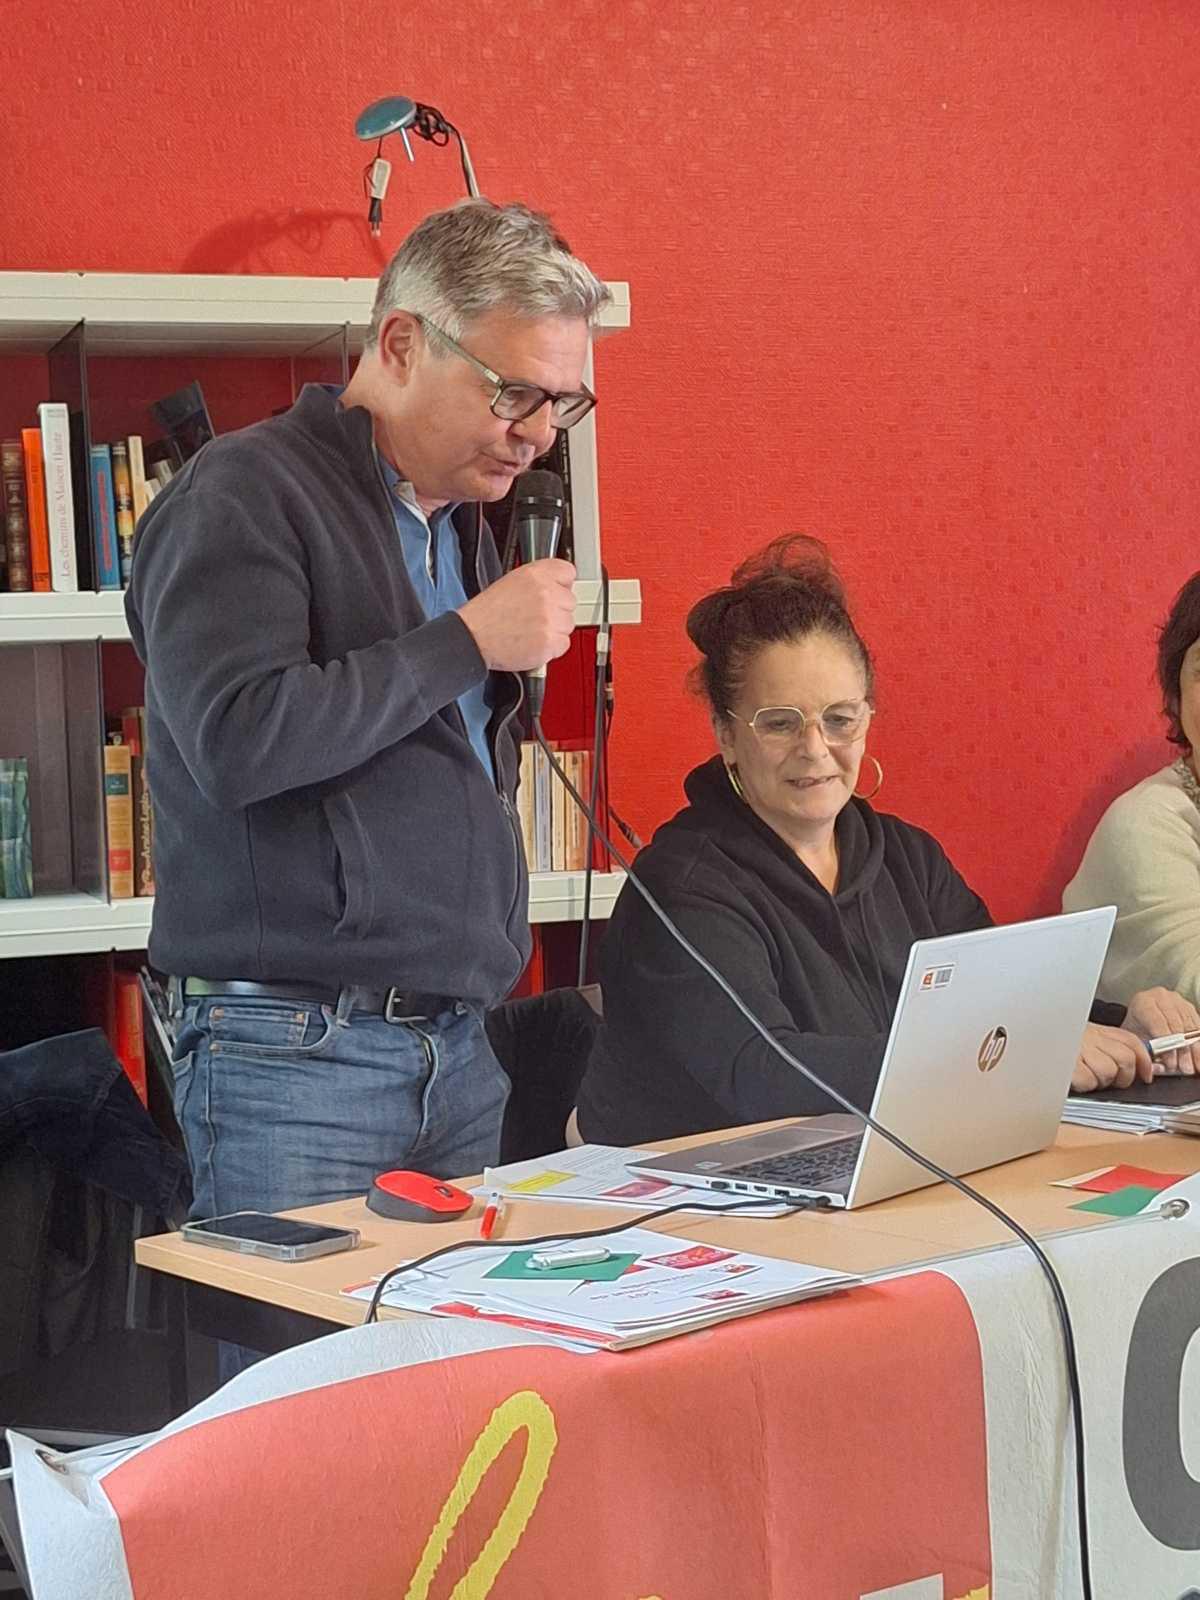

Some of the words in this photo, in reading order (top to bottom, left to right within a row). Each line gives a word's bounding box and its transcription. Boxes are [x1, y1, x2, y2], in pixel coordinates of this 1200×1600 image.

[54, 463, 66, 501] Maison
[56, 503, 66, 515] de
[57, 517, 70, 558] chemins
[60, 559, 71, 577] Les
[979, 1025, 1007, 1072] hp
